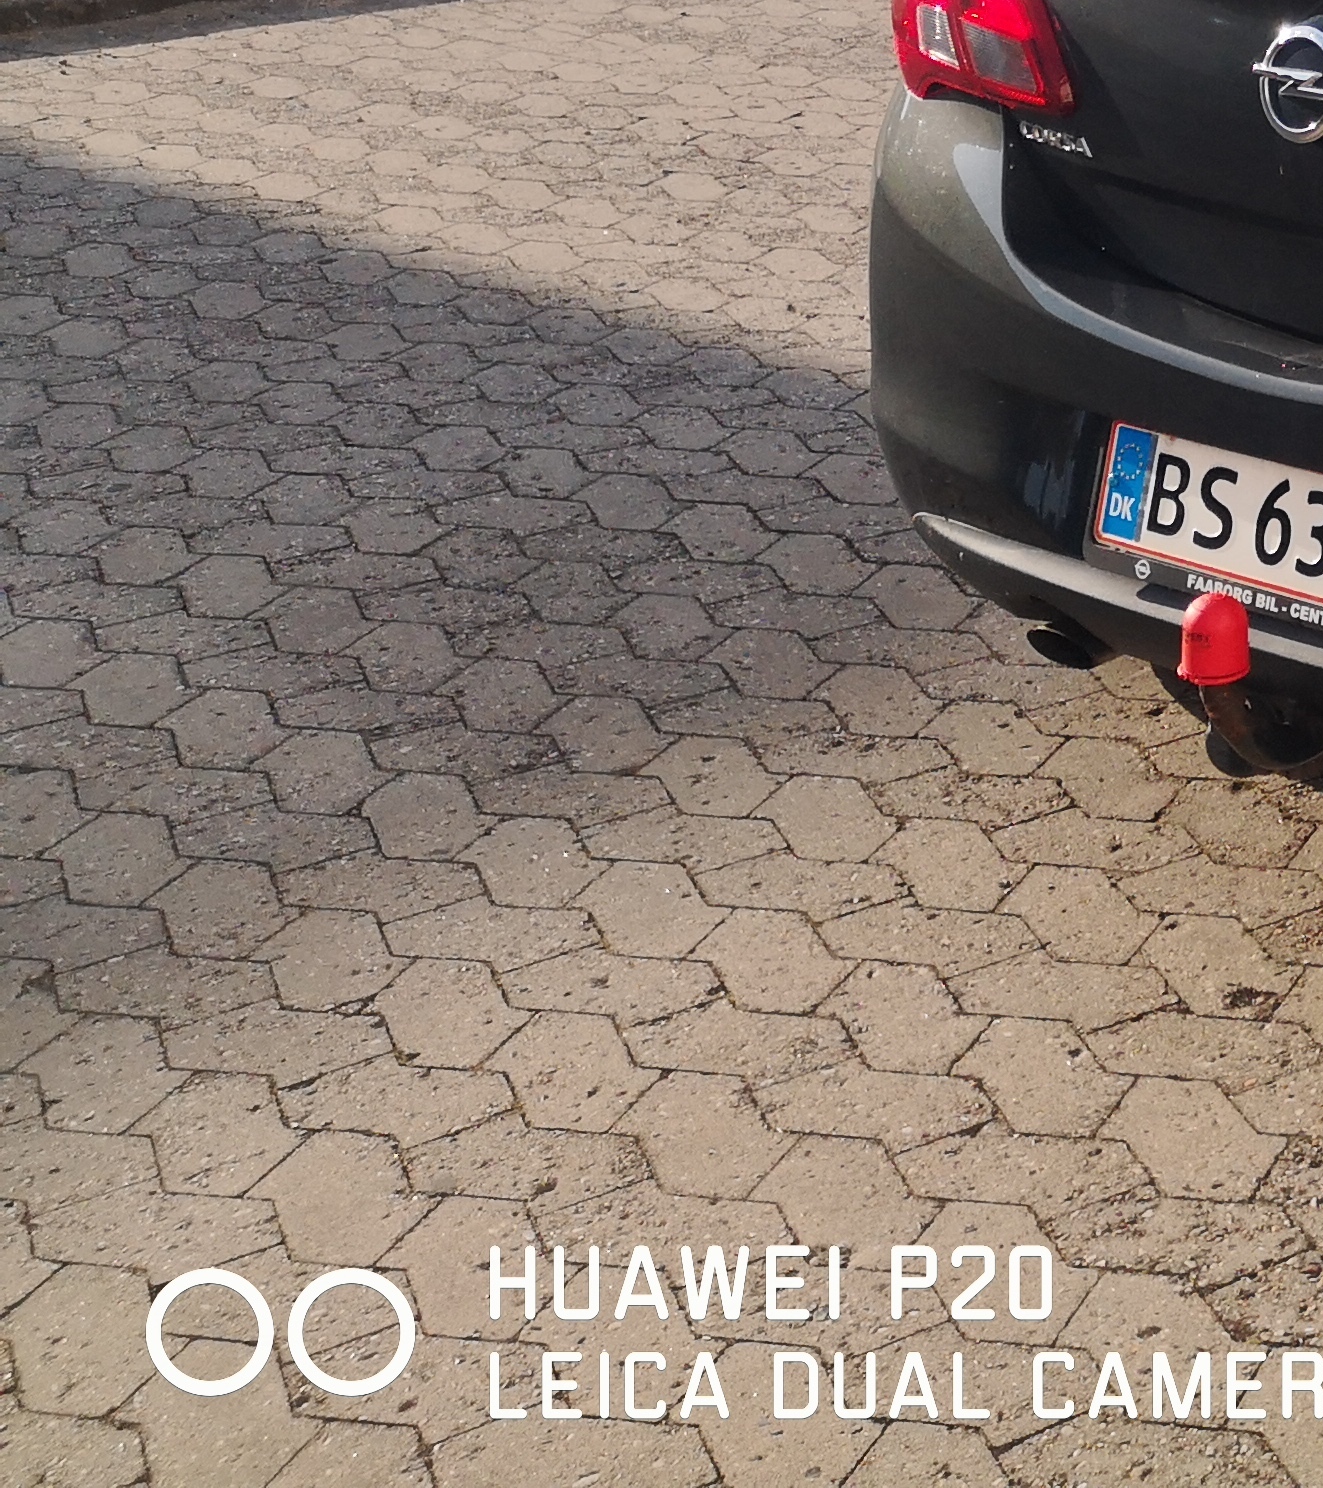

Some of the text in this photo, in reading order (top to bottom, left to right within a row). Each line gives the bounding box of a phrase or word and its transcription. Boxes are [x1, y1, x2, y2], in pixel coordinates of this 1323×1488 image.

[1109, 492, 1135, 523] DK
[1146, 452, 1239, 551] BS
[1255, 592, 1279, 613] BIL
